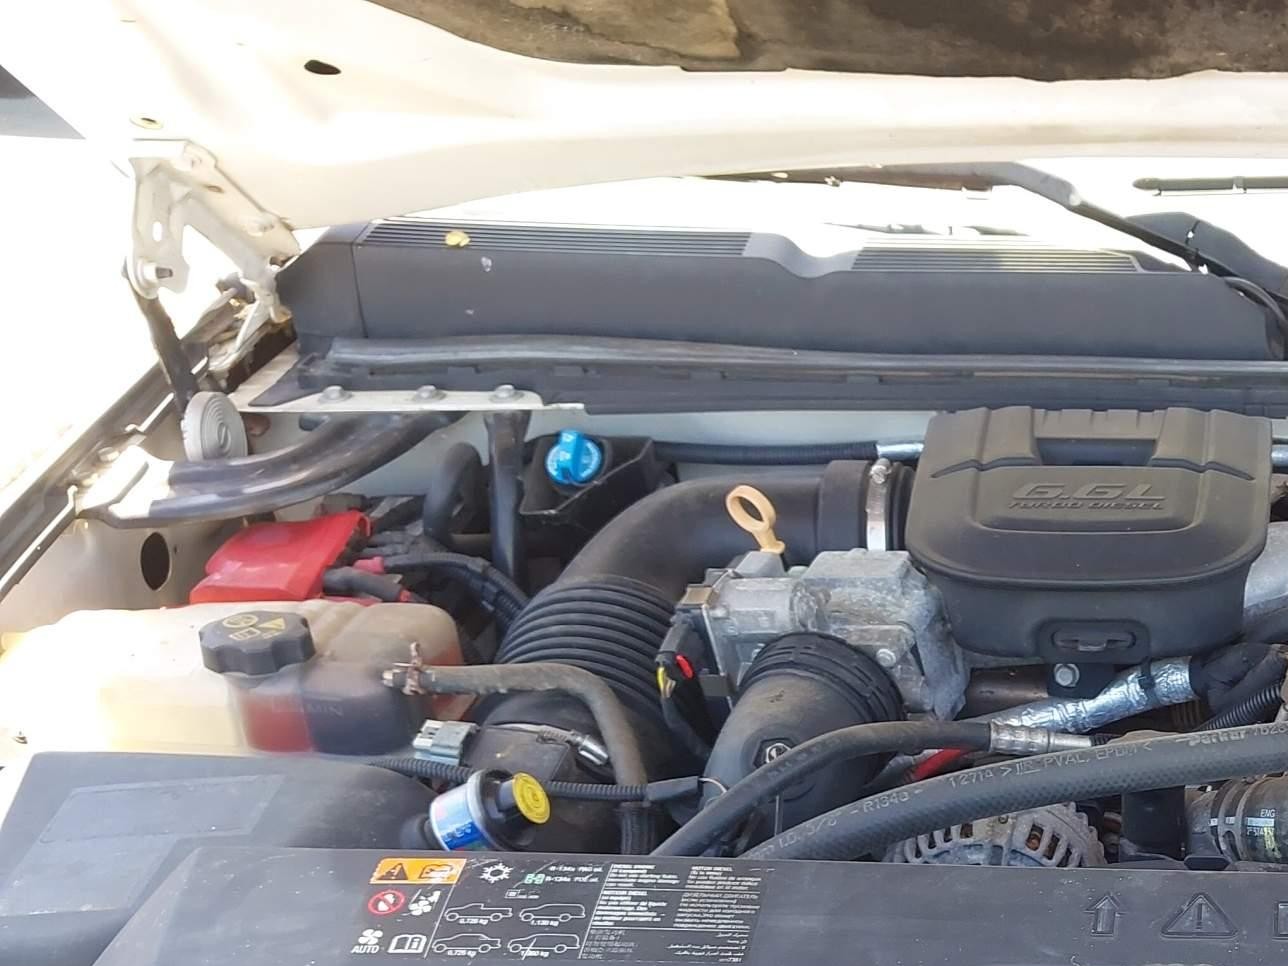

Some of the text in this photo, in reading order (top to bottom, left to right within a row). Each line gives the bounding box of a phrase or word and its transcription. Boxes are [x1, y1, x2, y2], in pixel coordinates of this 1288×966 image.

[1013, 483, 1166, 501] 6.6L
[862, 790, 911, 814] R134a
[1178, 730, 1248, 747] Parker
[1260, 808, 1276, 818] ENG
[350, 944, 380, 954] AUTO
